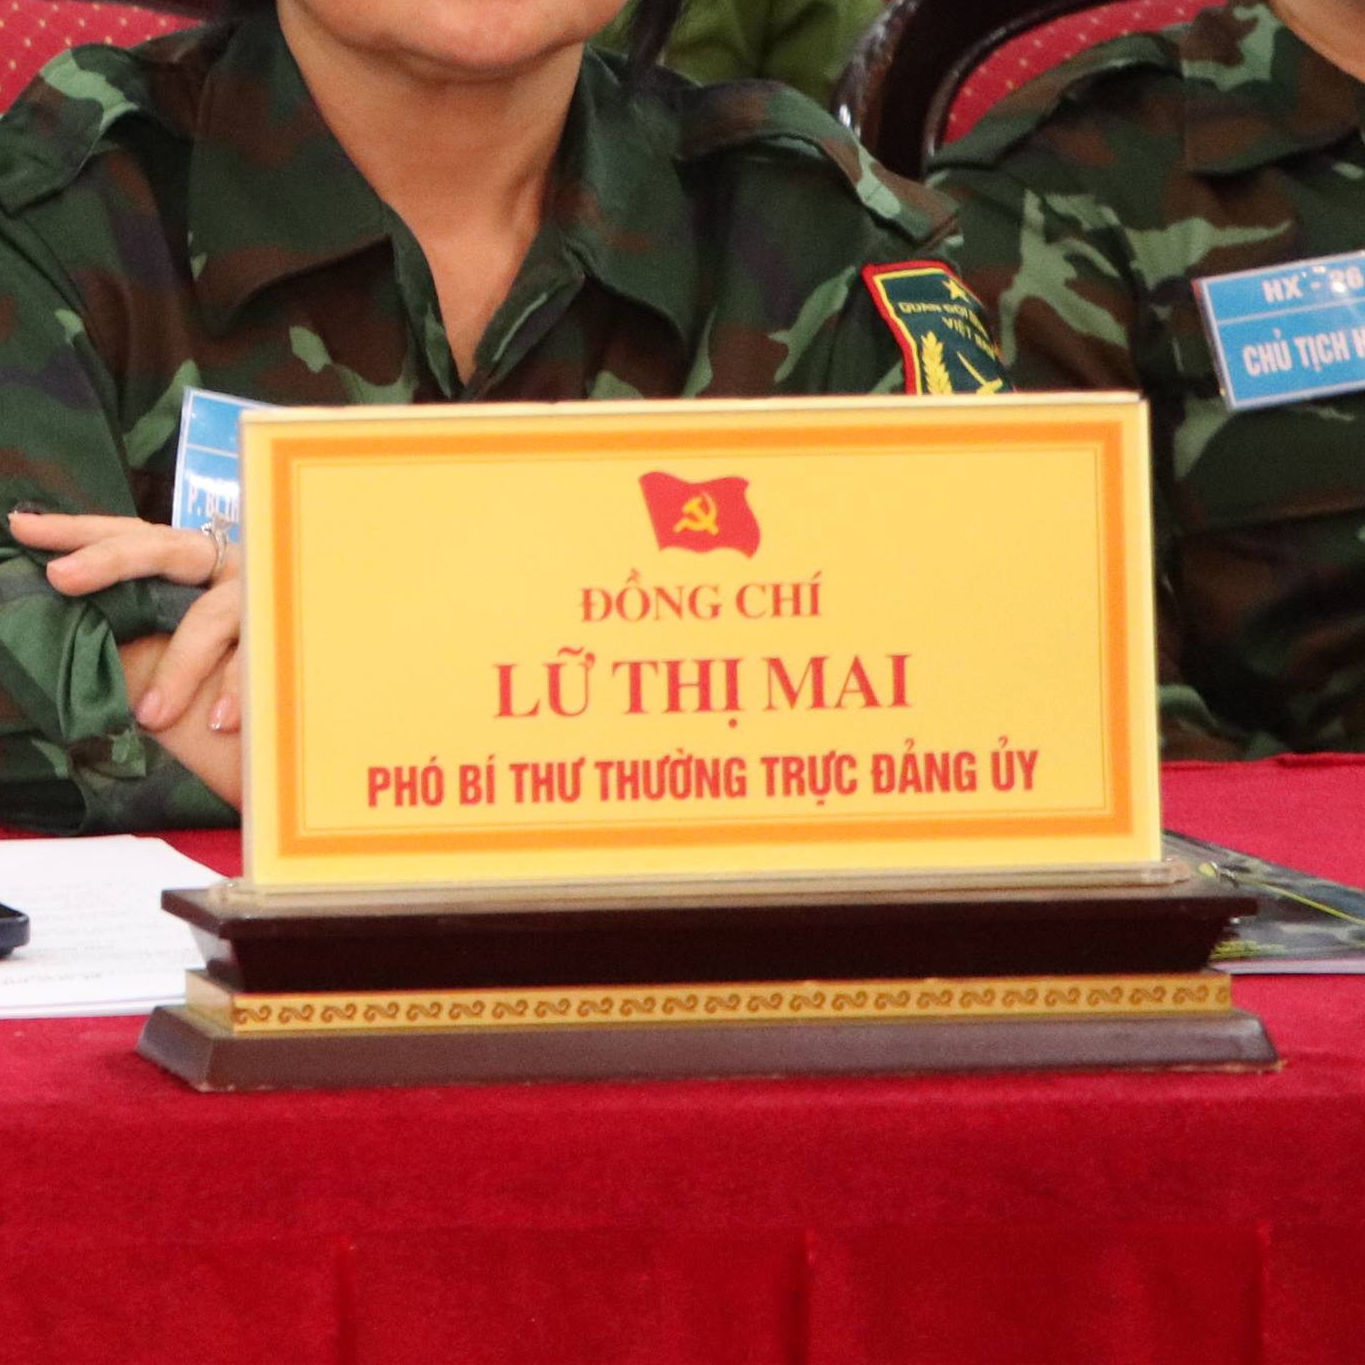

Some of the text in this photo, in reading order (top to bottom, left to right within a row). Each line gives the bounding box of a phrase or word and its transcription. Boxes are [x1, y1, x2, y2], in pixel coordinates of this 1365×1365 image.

[1262, 274, 1303, 303] HX
[1243, 327, 1293, 377] CHỦ
[1293, 330, 1351, 373] TỊCH
[578, 567, 823, 623] ĐỒNG CHÍ
[493, 644, 913, 730] LỮ THỊ MAI
[366, 734, 1041, 809] PHÓ BÍ THƯ THƯỜNG TRỰC ĐẢNG ỦY
